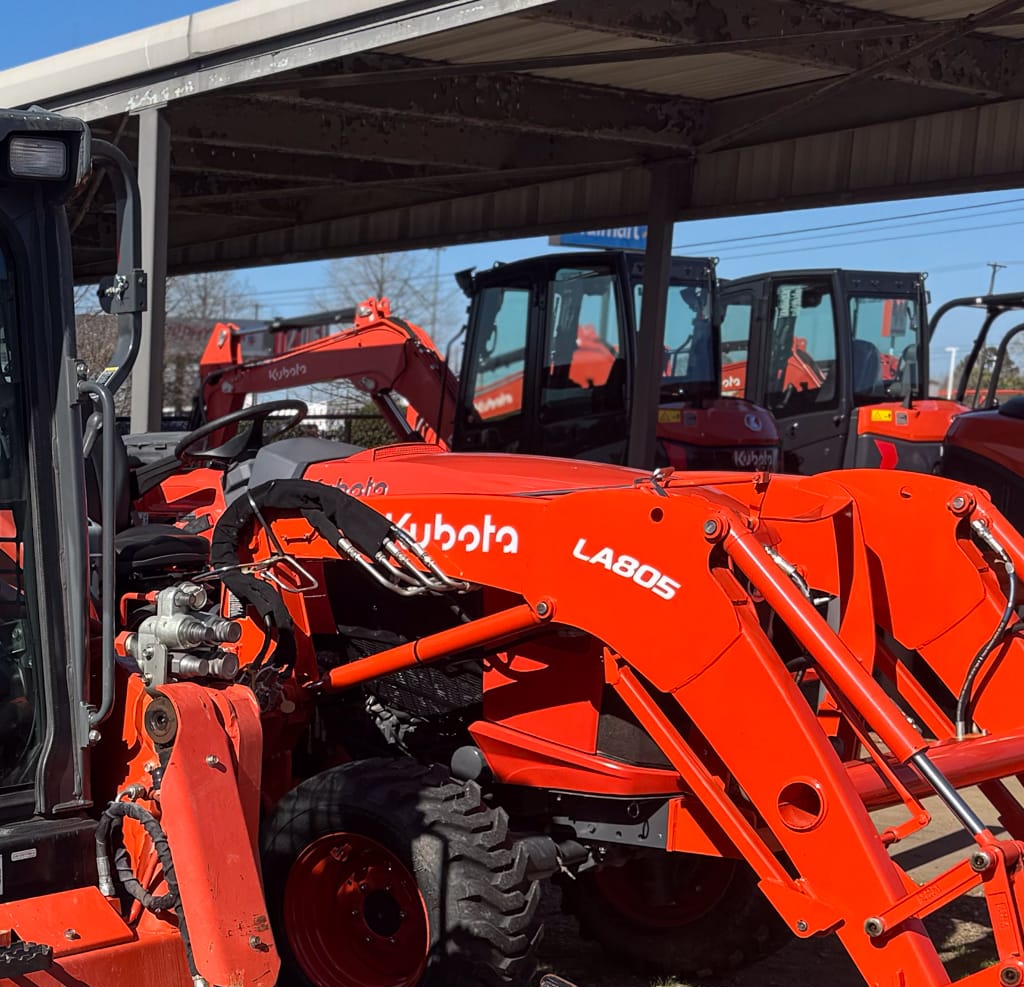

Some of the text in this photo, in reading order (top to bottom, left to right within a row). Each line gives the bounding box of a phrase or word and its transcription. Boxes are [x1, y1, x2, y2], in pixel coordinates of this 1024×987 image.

[268, 363, 307, 381] Kubota
[337, 477, 388, 496] bota
[572, 537, 682, 601] LA805
